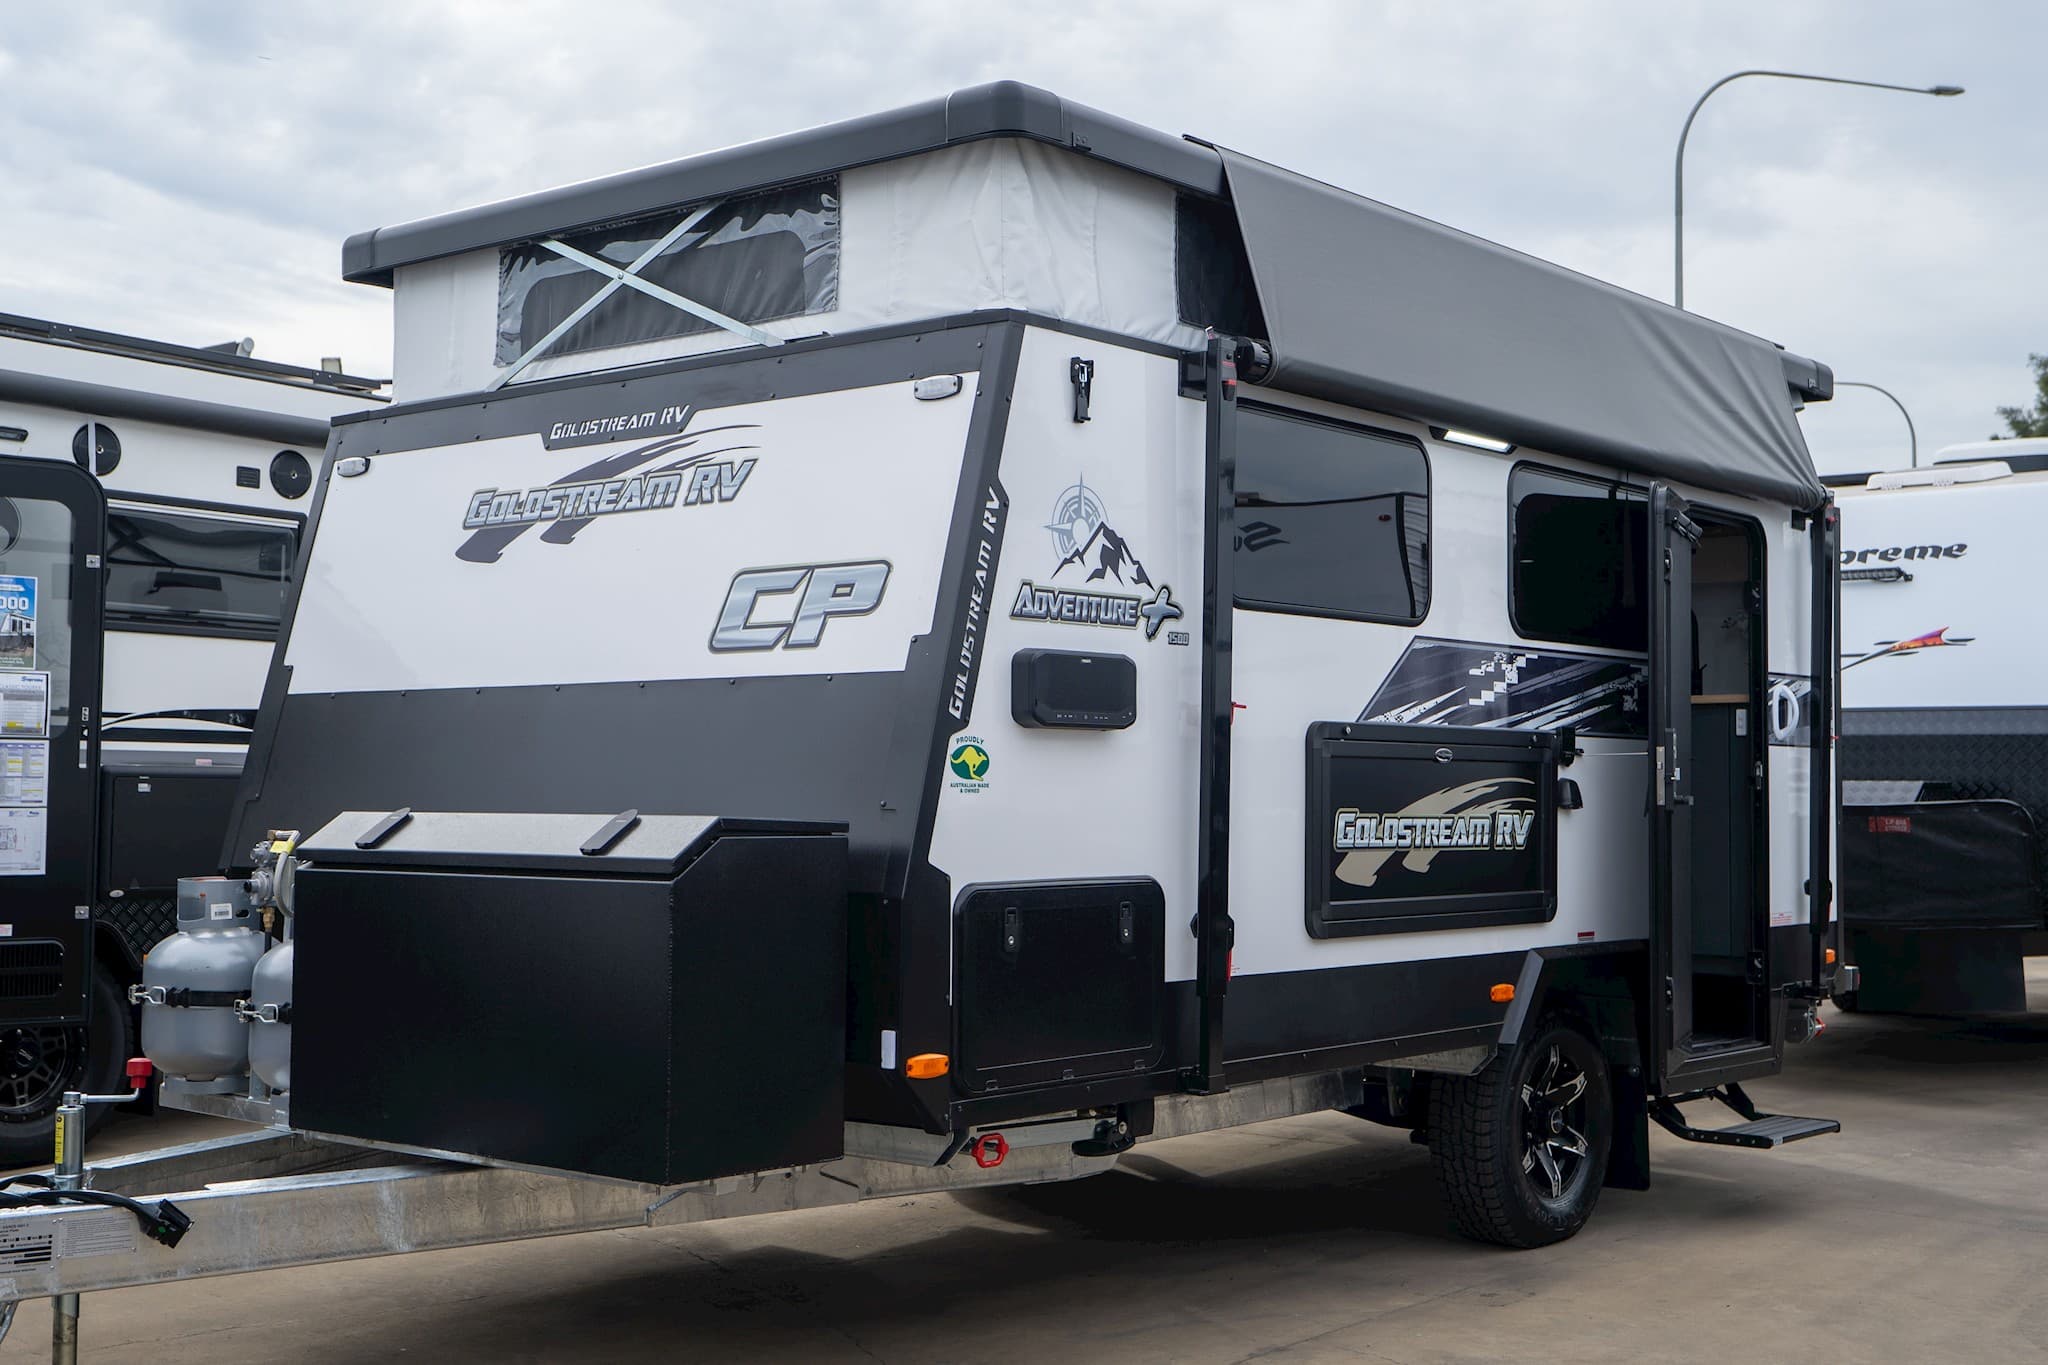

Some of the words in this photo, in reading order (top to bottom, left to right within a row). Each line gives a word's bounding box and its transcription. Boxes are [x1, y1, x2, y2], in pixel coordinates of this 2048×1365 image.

[549, 411, 656, 440] GOLDSTREAM
[660, 404, 690, 425] RV
[463, 473, 683, 530] GOLDSTREAM
[683, 458, 758, 506] RV
[709, 559, 892, 653] CP
[949, 539, 992, 720] GOLDSTREAM
[982, 486, 1001, 534] RV
[1168, 631, 1189, 646] 1500
[956, 735, 985, 744] PROUDLY
[1335, 808, 1491, 851] GOLDSTREAM
[1493, 810, 1535, 850] RV
